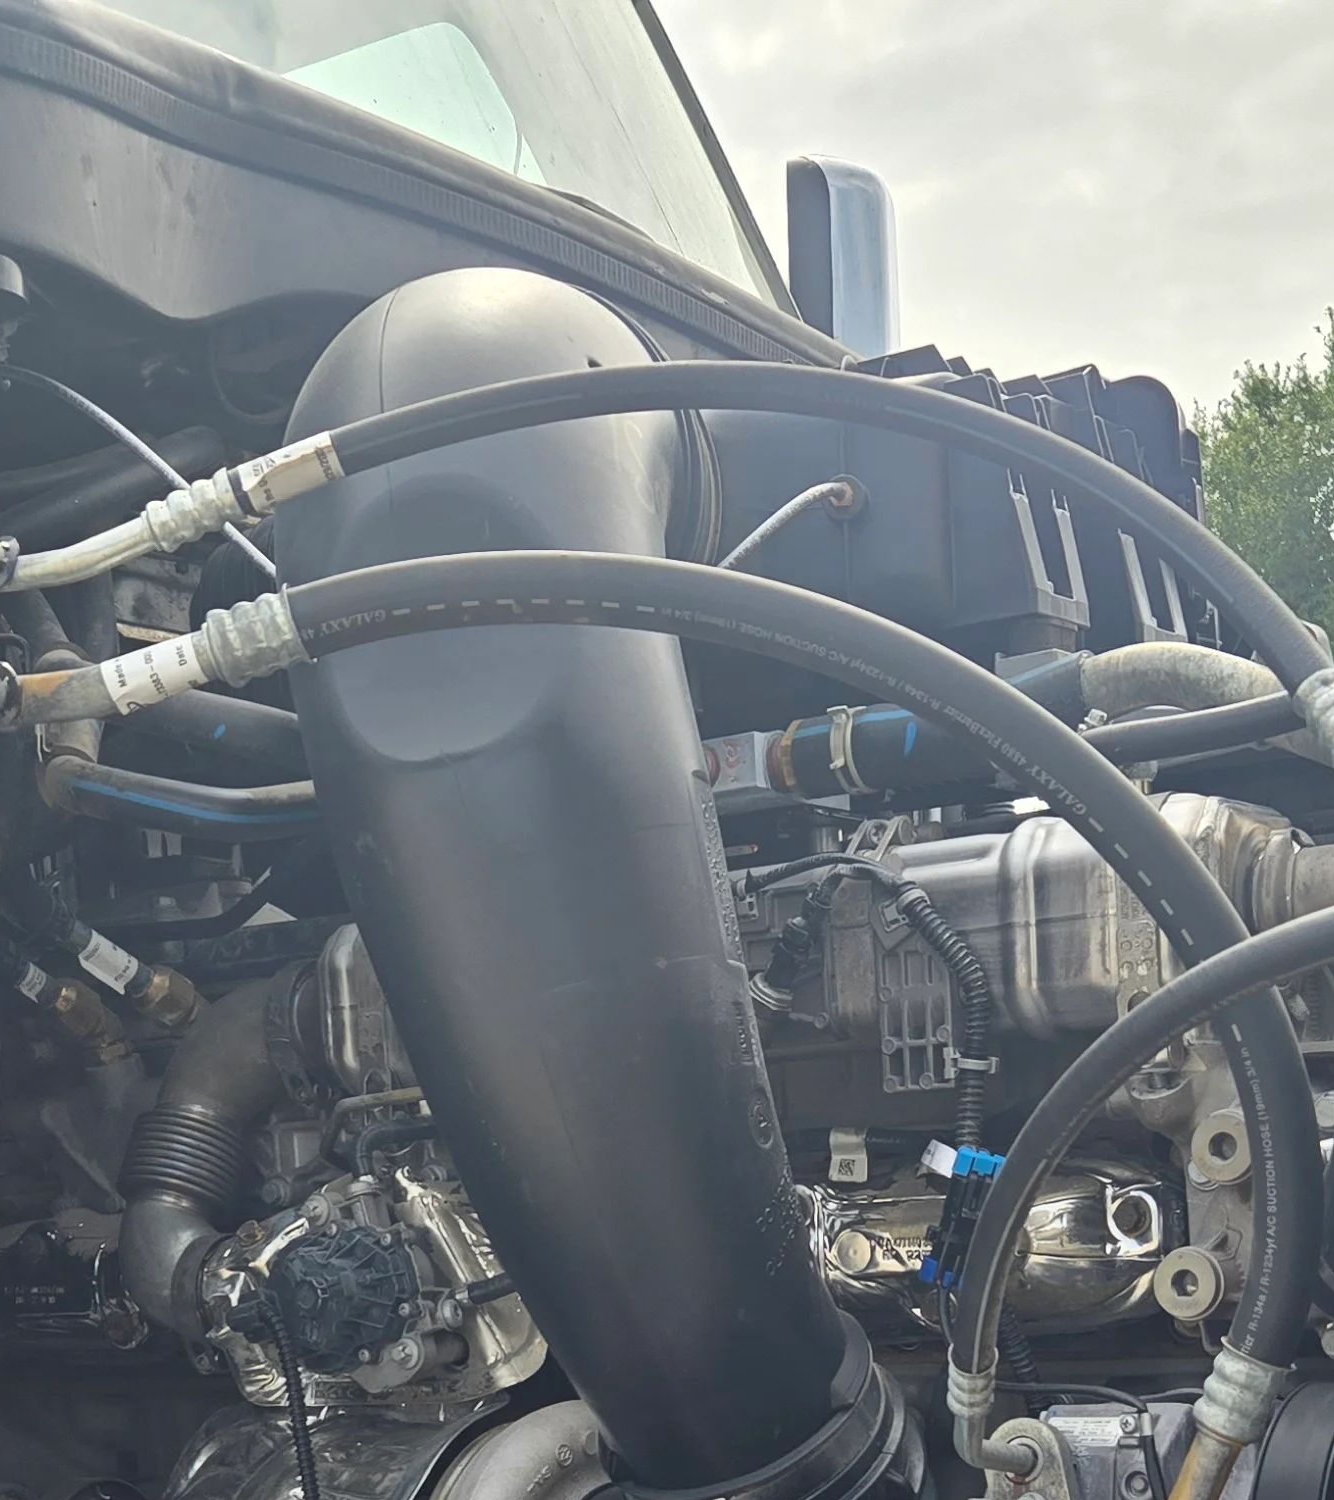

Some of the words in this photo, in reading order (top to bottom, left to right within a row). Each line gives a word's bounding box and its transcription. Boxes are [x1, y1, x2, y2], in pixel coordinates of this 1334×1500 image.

[320, 609, 387, 637] GALAXY
[675, 609, 692, 621] 3/4
[739, 621, 772, 640] HOSE
[175, 644, 187, 666] Date
[774, 632, 827, 658] SUCTION
[827, 650, 849, 665] A/C
[850, 659, 898, 688] R-1234yf
[904, 681, 941, 711] R-134a
[944, 704, 1002, 749] FlexBarrier
[1025, 764, 1087, 816] GALAXY
[1241, 1047, 1250, 1058] in
[1243, 1060, 1257, 1078] 3/4
[1250, 1079, 1269, 1121] (19mm)
[1260, 1123, 1274, 1157] HOSE
[1264, 1161, 1277, 1213] SUCTION
[1266, 1216, 1276, 1237] A/C
[1259, 1237, 1277, 1287] R-1234yf
[1247, 1295, 1267, 1332] R-134a
